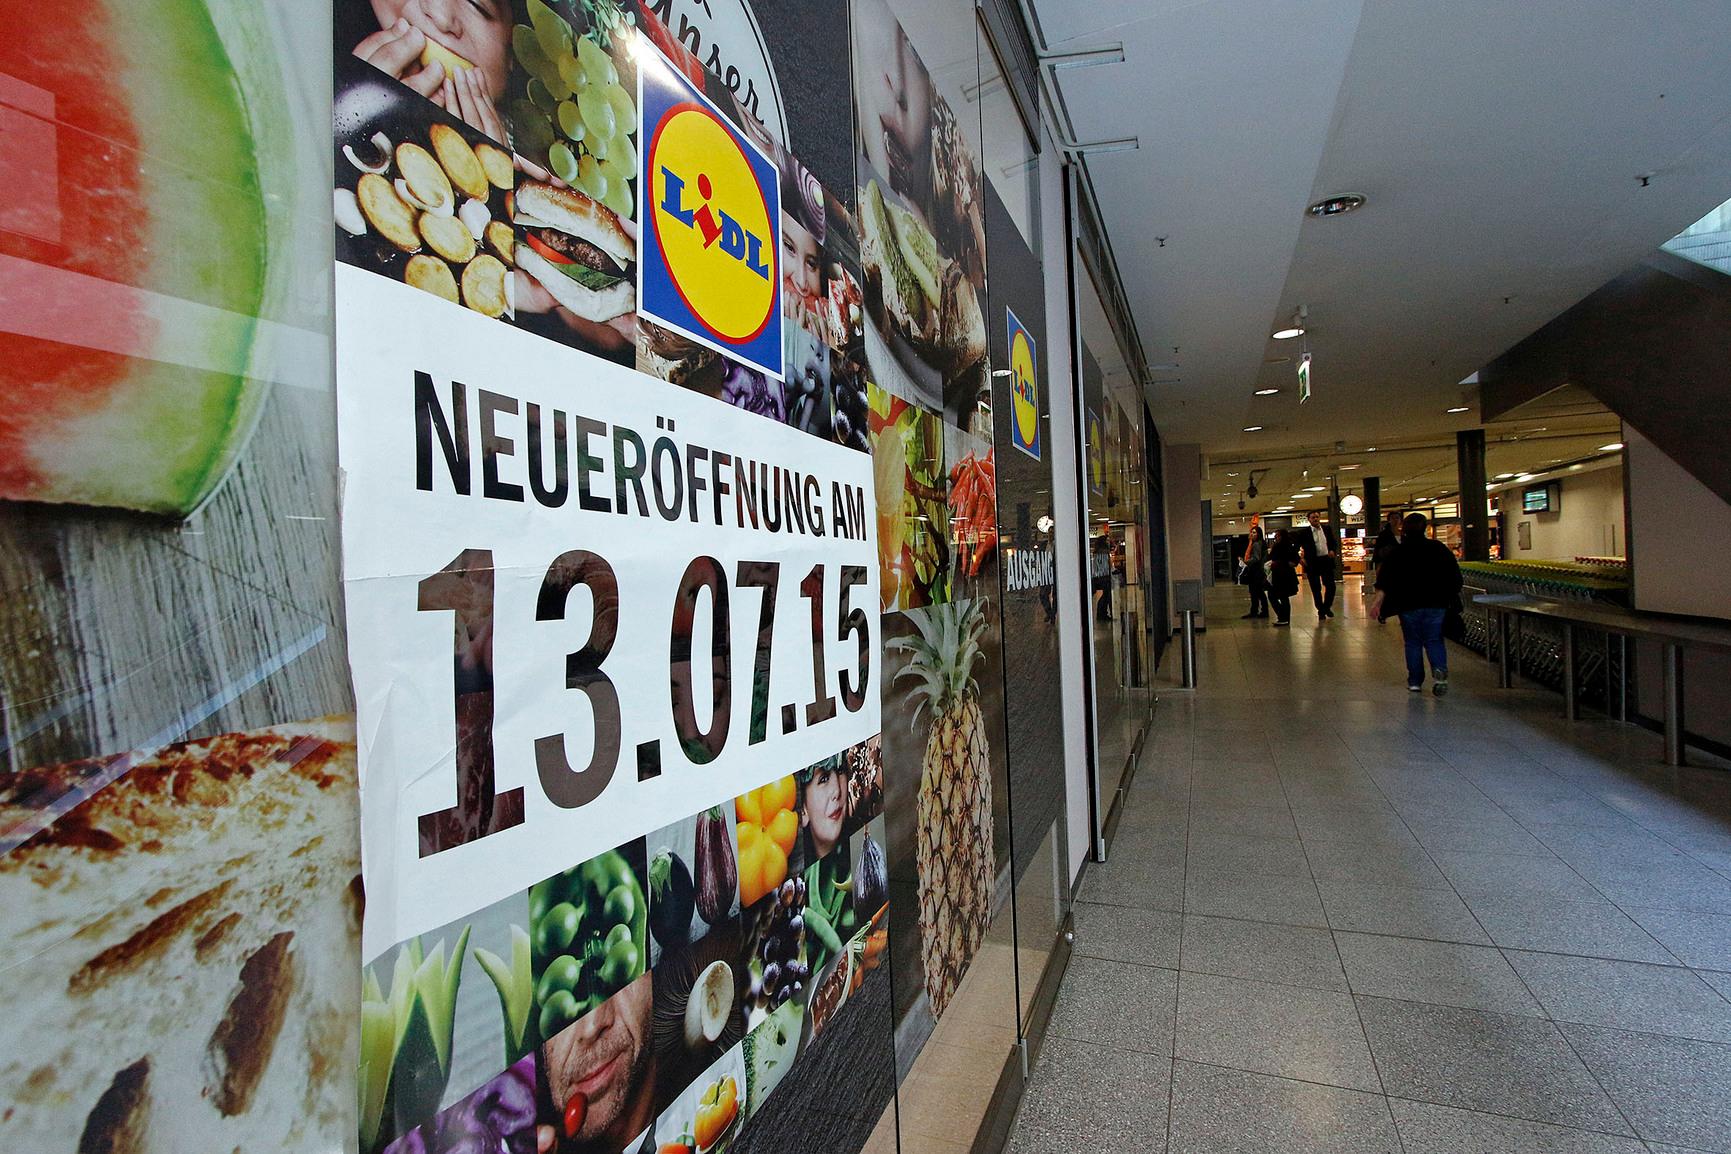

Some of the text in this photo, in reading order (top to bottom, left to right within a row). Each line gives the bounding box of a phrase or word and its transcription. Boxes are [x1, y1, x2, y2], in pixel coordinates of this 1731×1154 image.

[414, 370, 867, 541] NEUERÖFFNUNG AM
[1007, 550, 1053, 591] AUSGANG
[417, 548, 869, 858] 13.07.15
